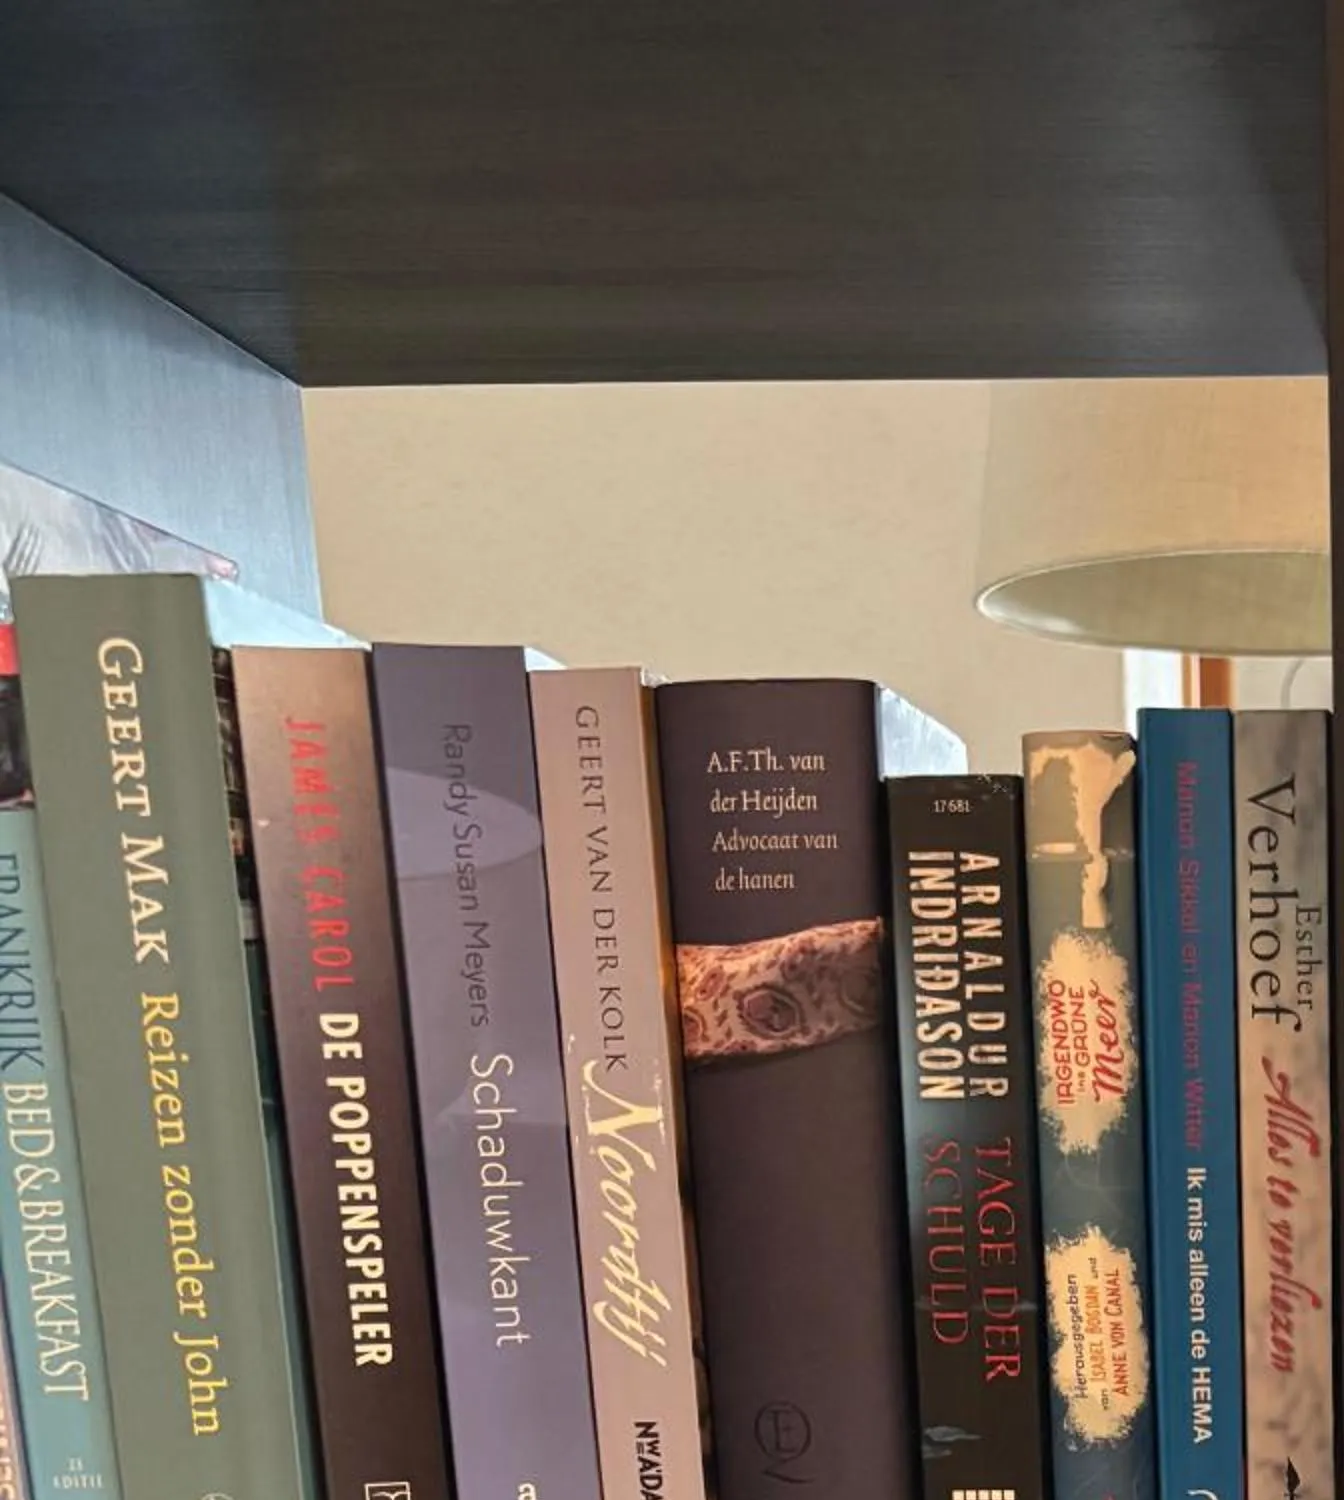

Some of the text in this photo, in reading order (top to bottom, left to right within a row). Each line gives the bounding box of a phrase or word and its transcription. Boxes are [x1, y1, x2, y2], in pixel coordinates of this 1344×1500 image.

[284, 718, 353, 992] JAMES CAROL
[710, 787, 818, 818] der Heijden
[712, 830, 839, 853] Advocaat van
[790, 754, 826, 771] van
[440, 723, 490, 1028] Randy Susan Meyers
[575, 705, 628, 1071] GEERT VAN DER KOLK
[715, 867, 796, 891] de hanen
[960, 852, 1009, 1097] ARNALDUR
[1182, 946, 1199, 973] en
[1248, 773, 1301, 1033] Verhoef
[1295, 905, 1327, 1011] Esther
[99, 637, 229, 1437] GEERT MAK Reizen zonder John
[1048, 979, 1075, 1104] IRGENDWO
[1088, 979, 1125, 1103] Meer
[319, 1013, 394, 1368] DE POPPENSPELER
[470, 1053, 532, 1347] Schaduwkant
[583, 1060, 670, 1367] Noordtij
[923, 1139, 969, 1345] SCHULD
[975, 1137, 1021, 1382] TAGE DER
[1104, 1267, 1122, 1316] CANAL
[1261, 1055, 1322, 1373] Alles te verliezen
[1067, 1274, 1088, 1400] Herausgegeben
[1111, 1353, 1129, 1397] ANNE
[1187, 1167, 1213, 1444] Ik mis alleen de HEMA
